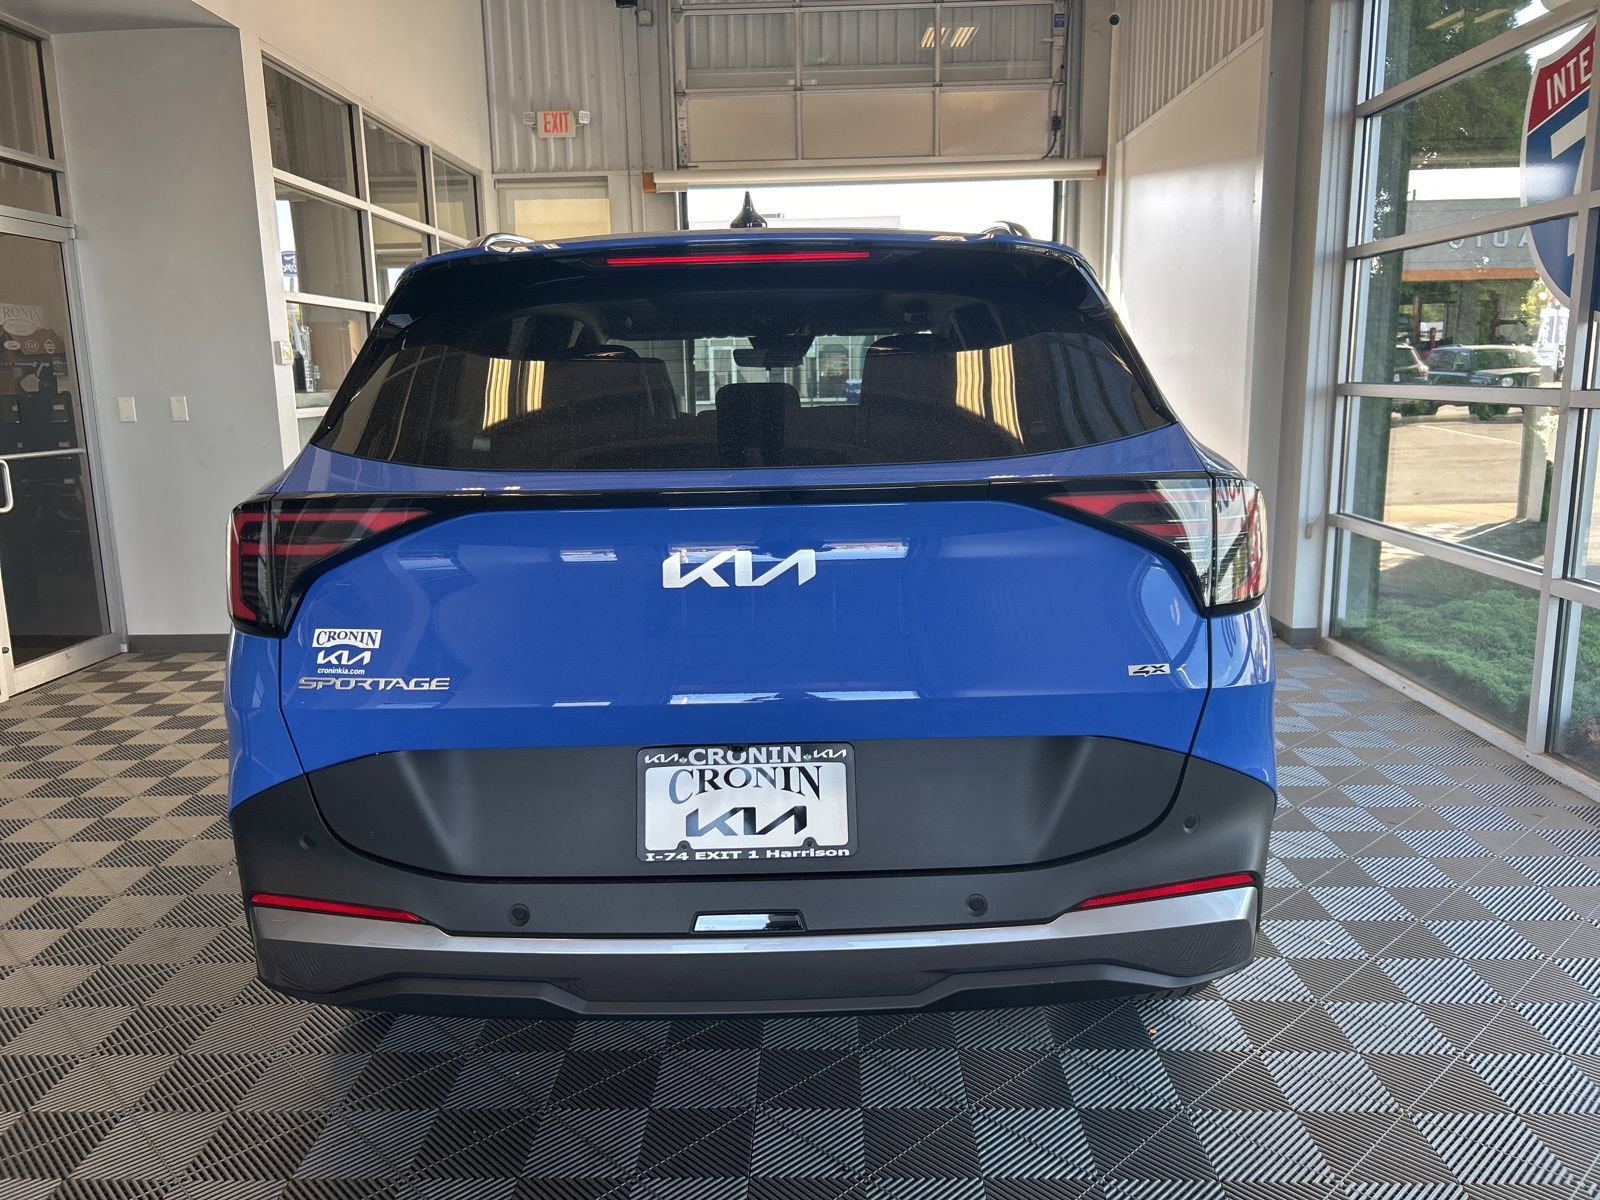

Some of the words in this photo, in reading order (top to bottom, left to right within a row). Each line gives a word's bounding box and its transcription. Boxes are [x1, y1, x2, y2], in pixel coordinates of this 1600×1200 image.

[543, 111, 569, 133] EXIT
[0, 305, 42, 325] RONIN
[662, 549, 816, 588] KIA
[316, 630, 378, 646] CRONIN
[316, 650, 371, 665] KIA
[317, 667, 365, 675] croninkia.com
[298, 677, 450, 691] SPORTAGE
[645, 753, 679, 764] KIA
[688, 745, 802, 765] CRONIN
[813, 749, 847, 759] KIA
[668, 765, 822, 805] CRONIN
[686, 805, 807, 837] KIA
[645, 852, 689, 862] I-74
[695, 851, 742, 860] EXIT
[748, 850, 759, 859] 1
[766, 848, 850, 858] Harrison
